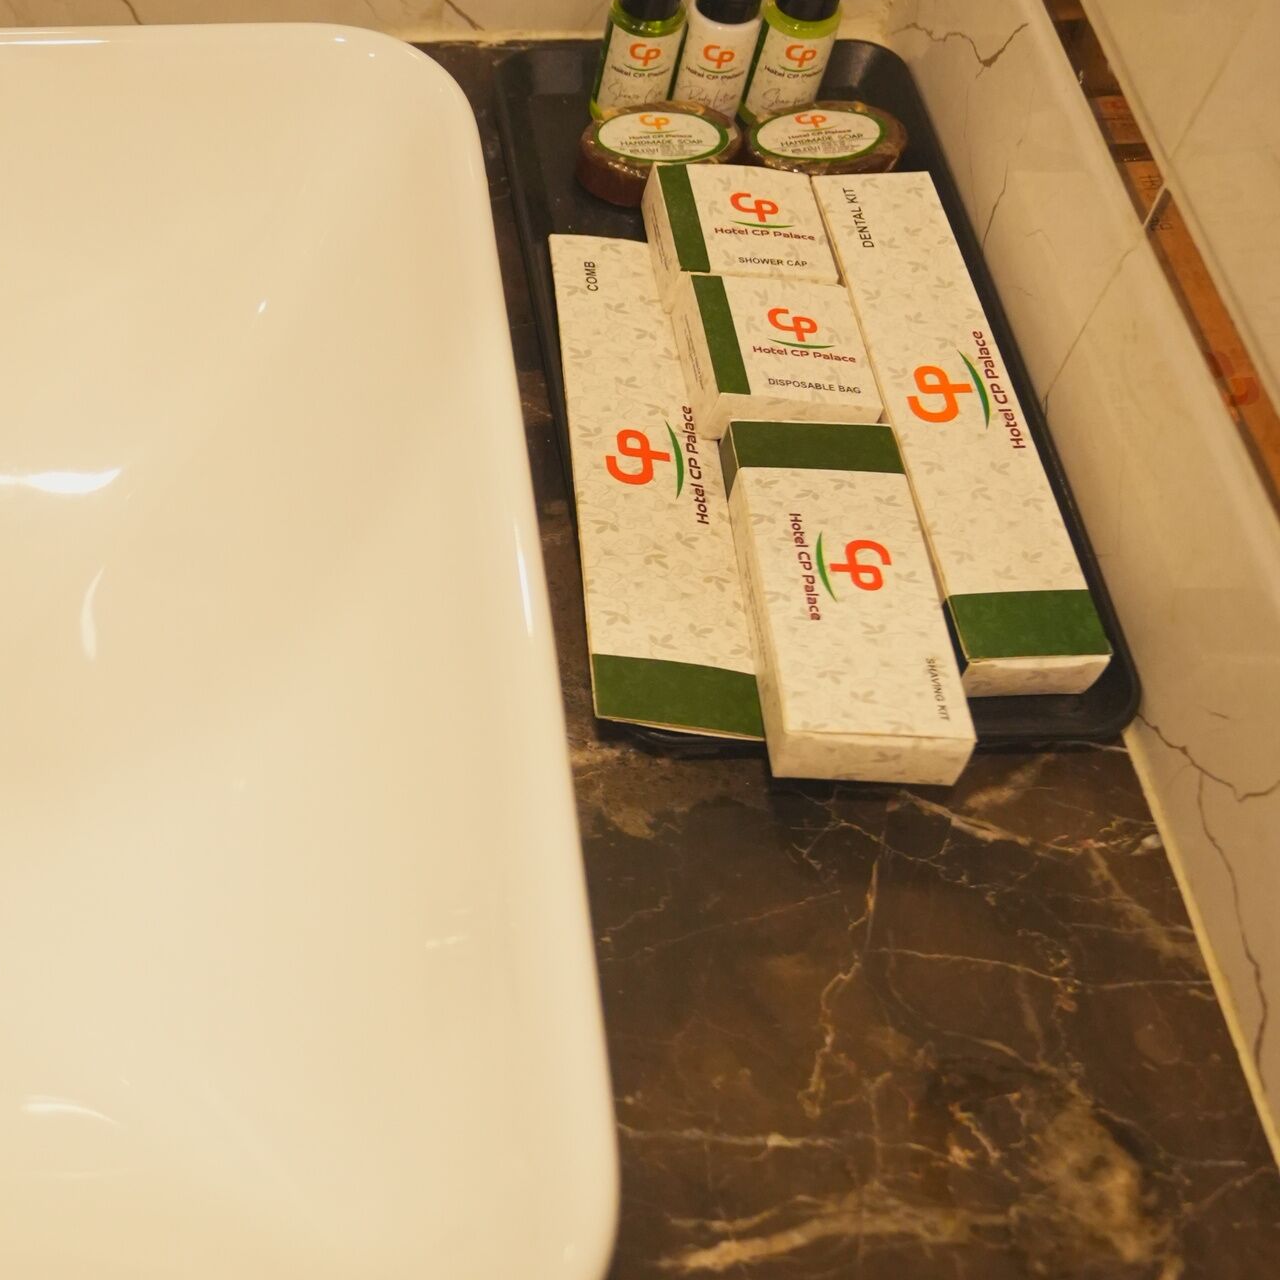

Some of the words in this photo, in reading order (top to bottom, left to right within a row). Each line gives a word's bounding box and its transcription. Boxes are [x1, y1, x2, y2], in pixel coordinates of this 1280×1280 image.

[780, 135, 832, 147] HANDMADE
[837, 132, 864, 141] SOAP
[842, 187, 859, 204] KIT
[714, 227, 749, 236] Hotel
[751, 229, 770, 237] CP
[773, 230, 816, 241] Palace
[851, 206, 875, 248] DENTAL
[738, 256, 784, 266] SHOWER
[786, 259, 808, 268] CAP
[583, 261, 599, 292] COMB
[752, 345, 788, 356] Hotel
[791, 349, 810, 358] CP
[813, 351, 857, 364] Palace
[972, 330, 999, 380] Palace
[768, 377, 836, 392] DISPOSABLE
[838, 384, 862, 395] BAG
[989, 383, 1009, 405] CP
[682, 405, 699, 454] Palace
[998, 408, 1026, 449] Hotel
[687, 457, 702, 480] CP
[690, 483, 709, 525] Hotel
[789, 513, 809, 548] Hotel
[797, 551, 813, 571] CP
[802, 574, 822, 621] Palace
[925, 658, 946, 702] SHAVING
[937, 704, 951, 721] KIT
